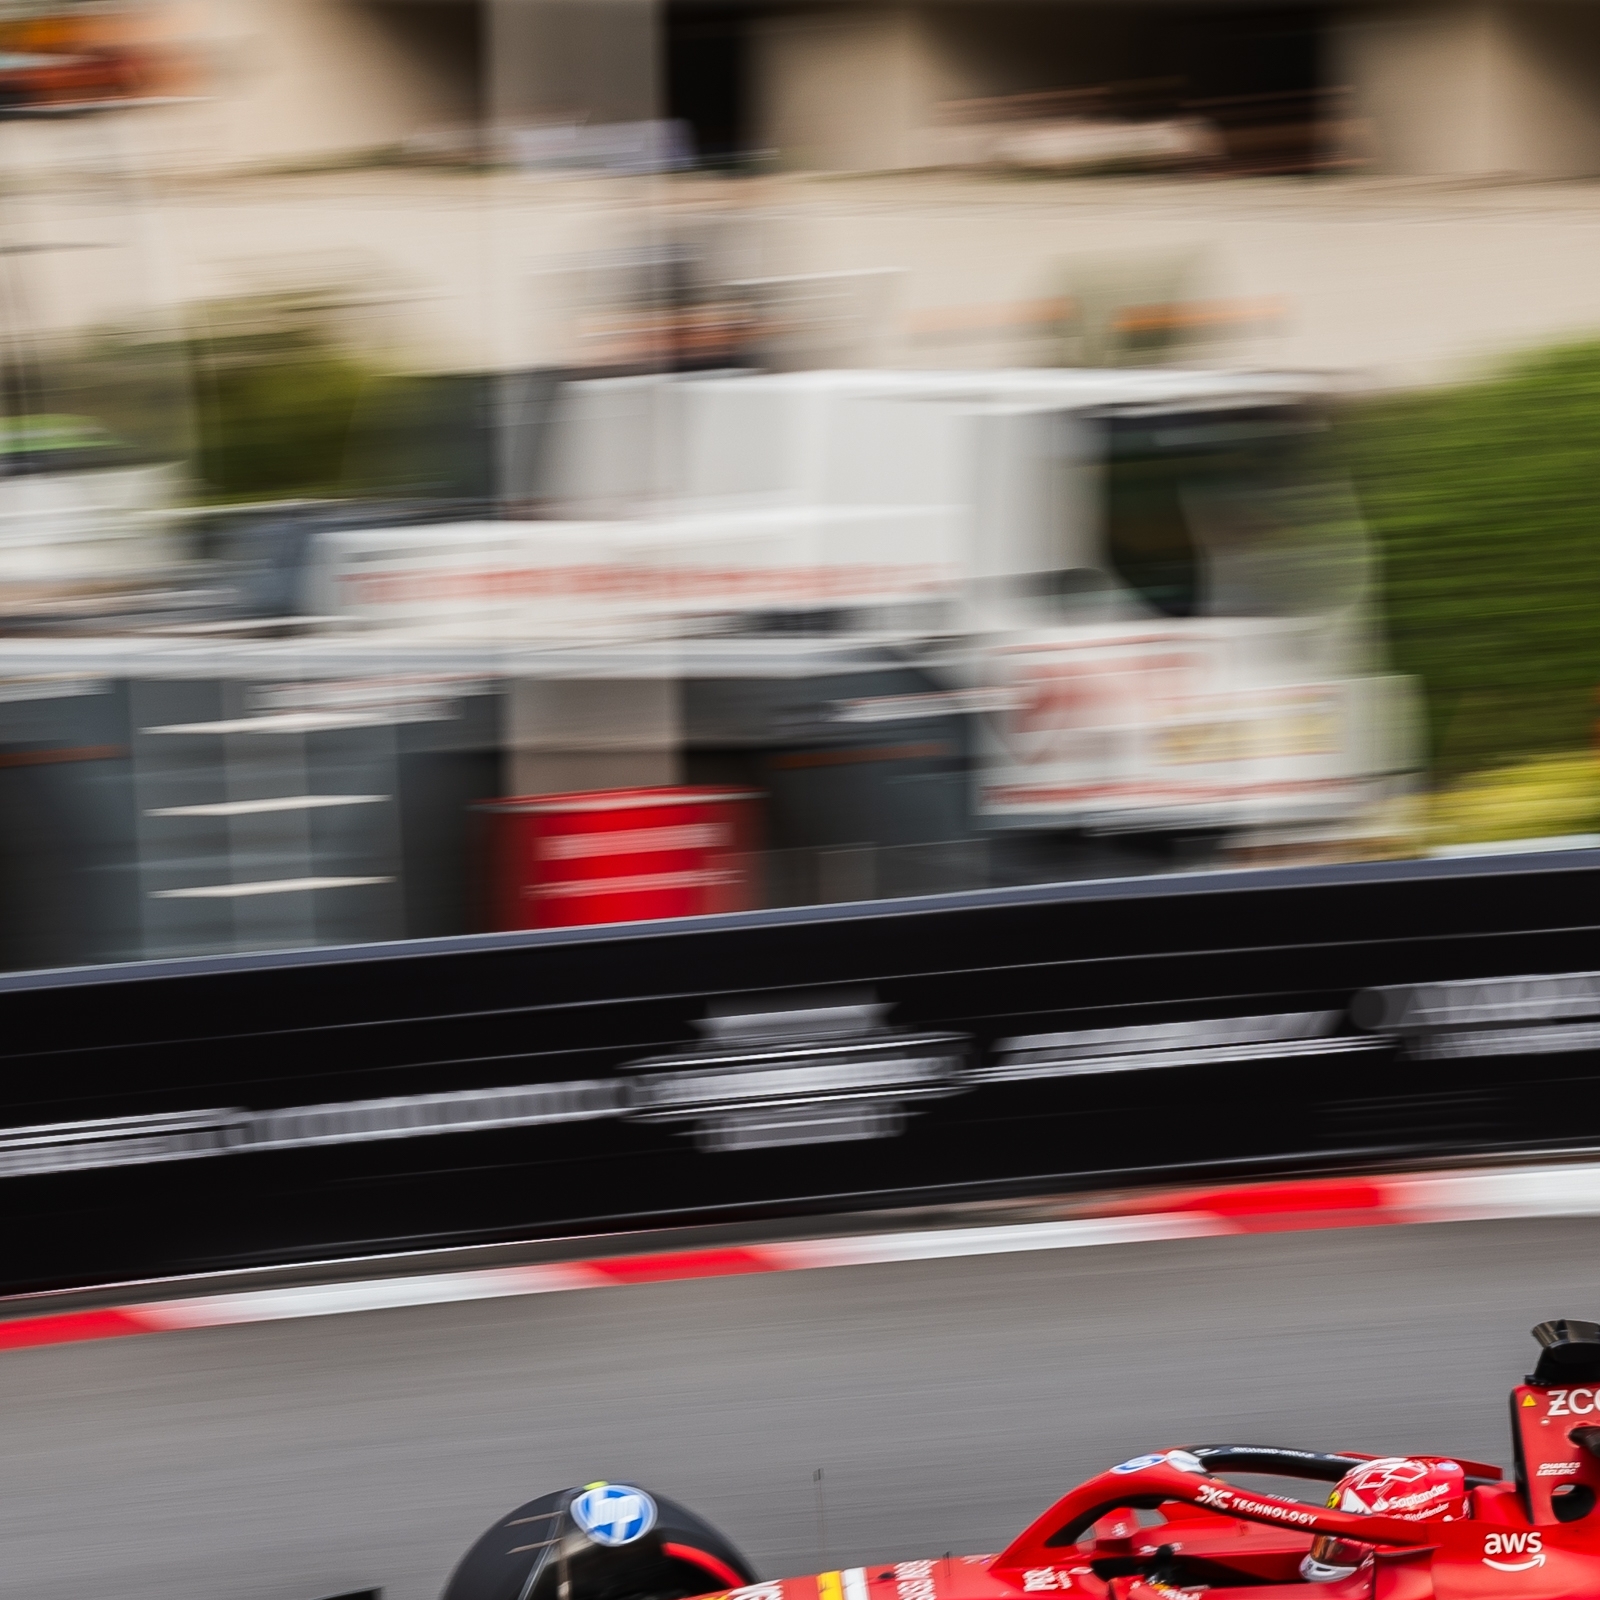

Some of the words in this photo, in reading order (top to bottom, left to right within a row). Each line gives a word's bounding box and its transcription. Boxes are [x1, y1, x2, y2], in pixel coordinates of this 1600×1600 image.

[1536, 1468, 1576, 1476] LECLERC
[1538, 1461, 1581, 1470] CHARLES
[1389, 1482, 1450, 1509] Santander
[1232, 1496, 1318, 1526] TECHNOLOGY
[1483, 1531, 1543, 1555] aws
